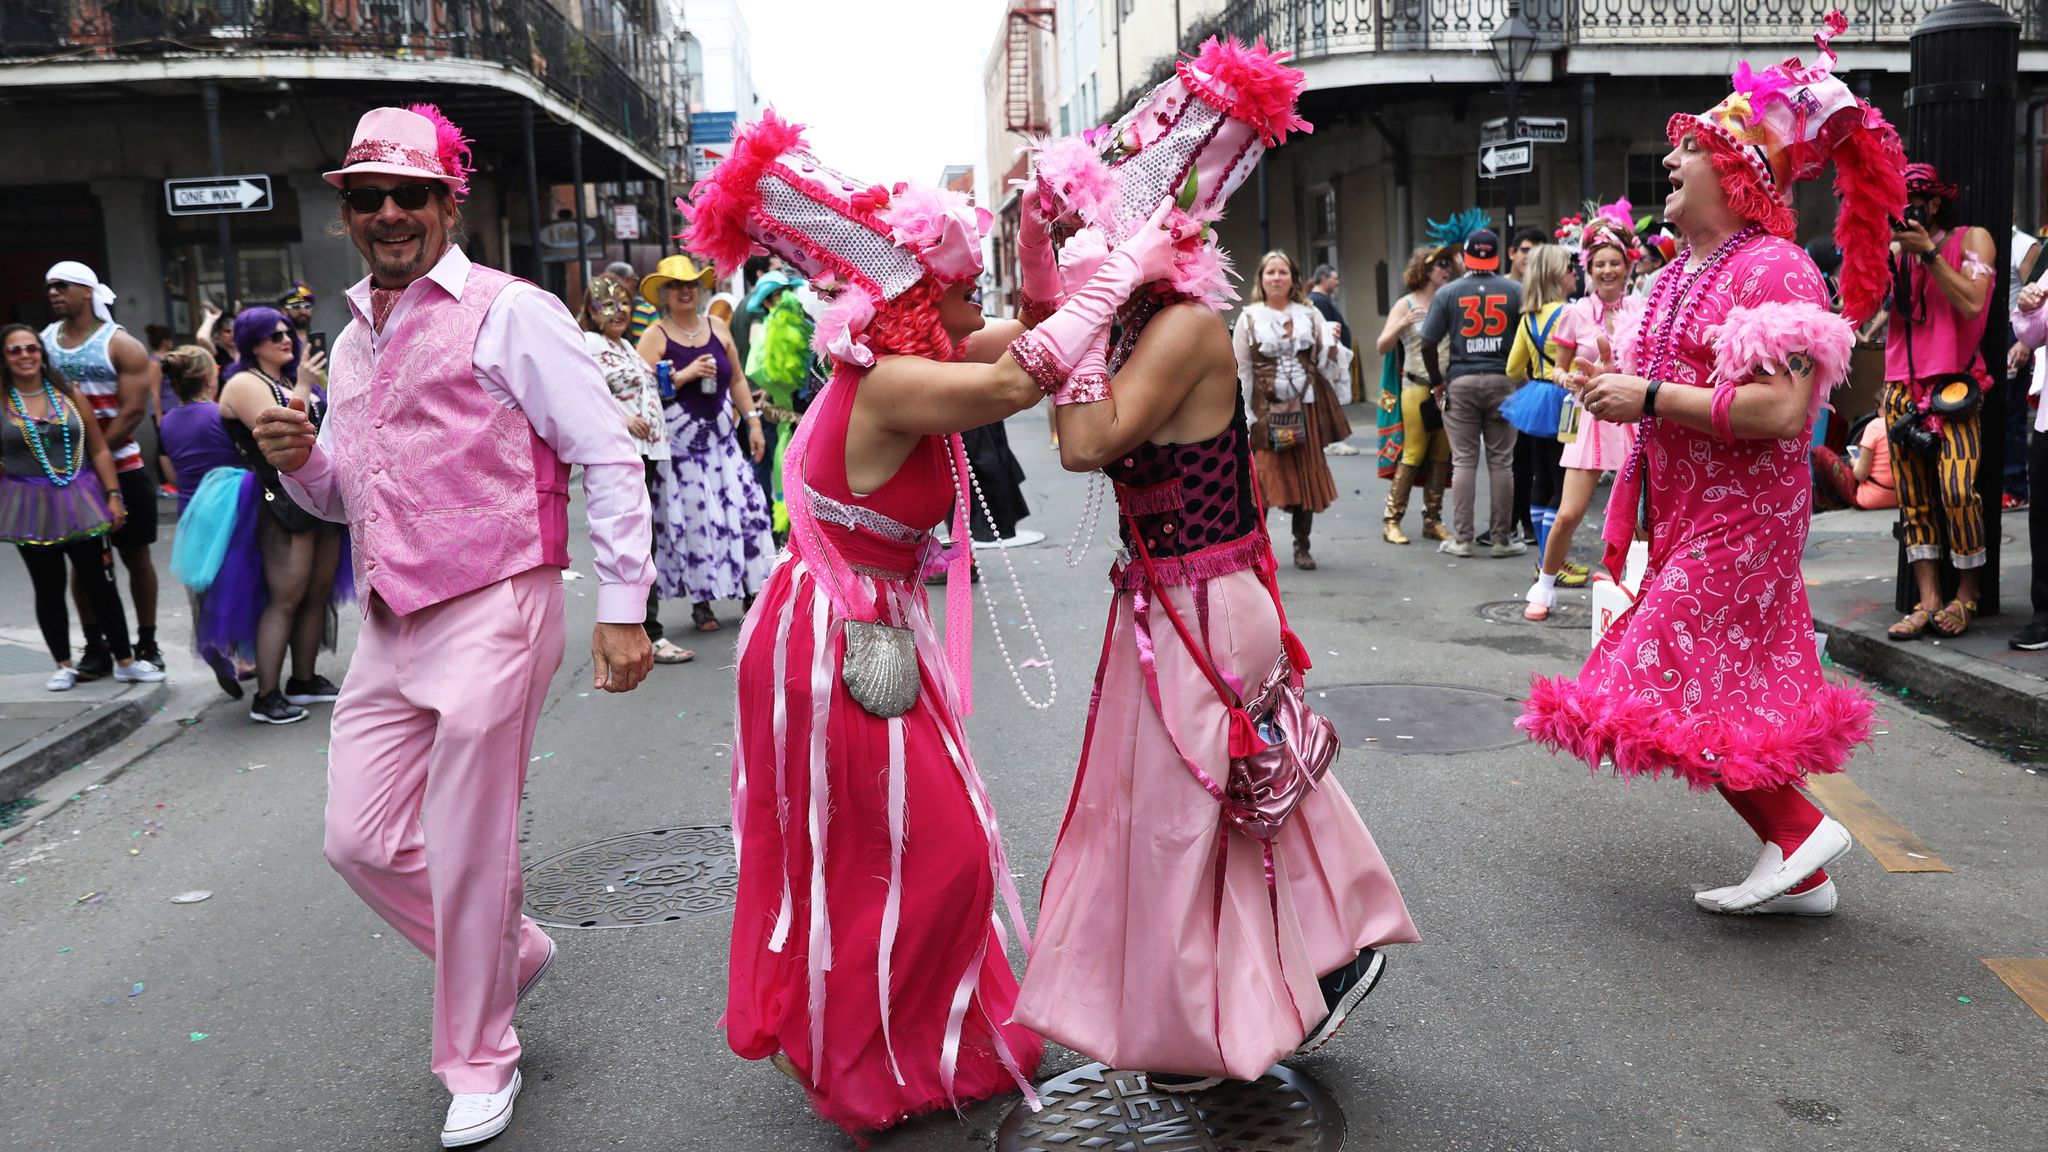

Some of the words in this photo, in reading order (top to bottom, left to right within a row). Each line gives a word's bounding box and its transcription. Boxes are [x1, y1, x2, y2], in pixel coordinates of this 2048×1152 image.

[1518, 126, 1563, 138] Chartres
[180, 191, 208, 205] ONE
[210, 189, 239, 202] WAY
[1459, 294, 1507, 337] 35
[1466, 337, 1503, 353] DURANT
